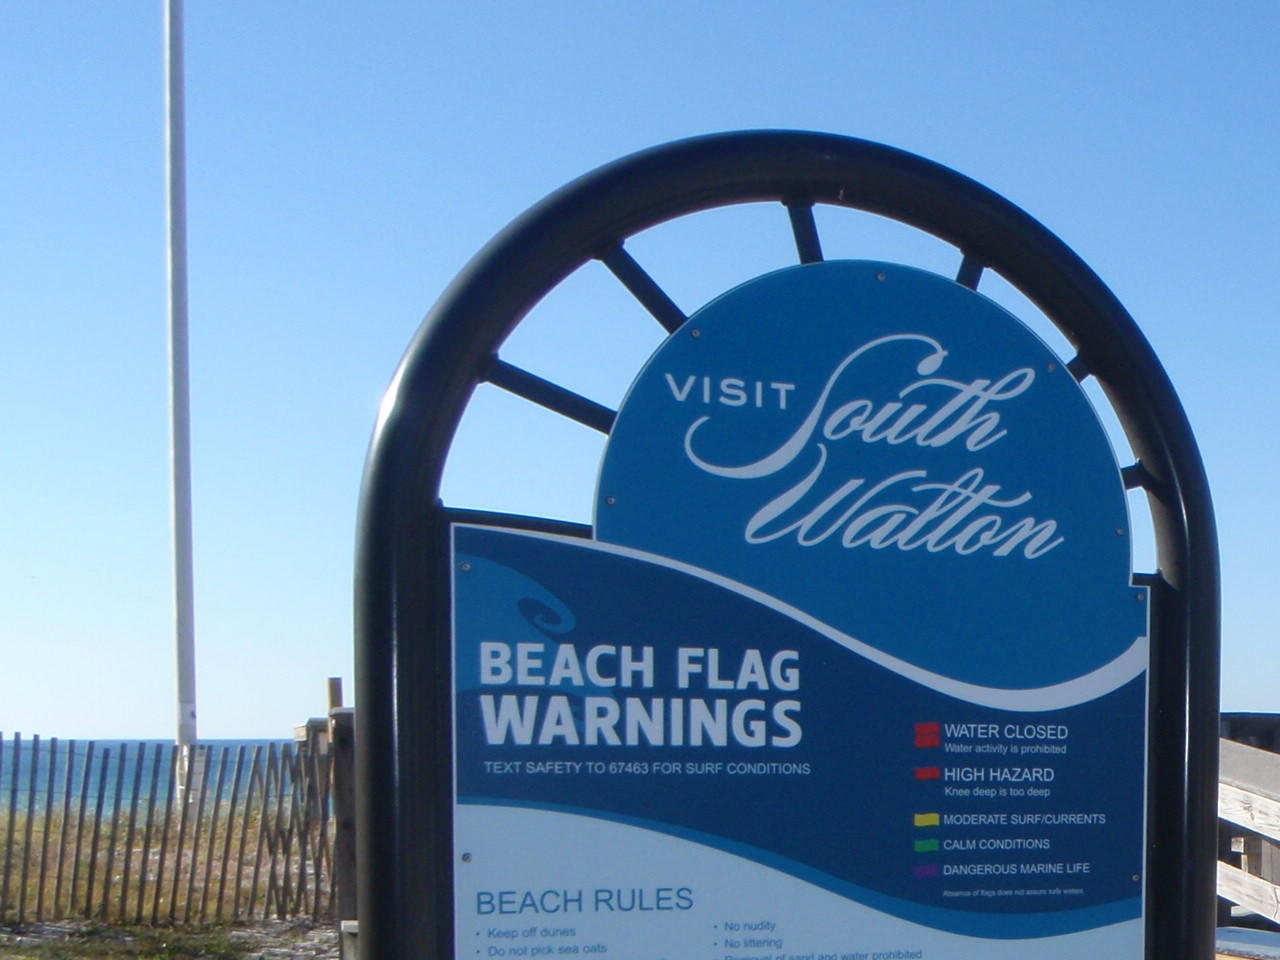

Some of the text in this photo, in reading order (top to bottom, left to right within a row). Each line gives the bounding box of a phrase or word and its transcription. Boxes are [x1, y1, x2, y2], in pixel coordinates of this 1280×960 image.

[665, 333, 1035, 480] VISIT South
[745, 443, 1065, 560] Walton
[481, 643, 799, 691] BEACH FLAG
[480, 695, 802, 747] WARNINGS
[945, 724, 1068, 739] WATER CLOSED
[945, 743, 1066, 755] Water activity is prohibited
[484, 762, 811, 775] TEXT SAFETY TO 67463 FOR SURF CONDITIONS
[945, 768, 1054, 782] HIGH HAZARD
[945, 787, 1050, 798] Knee deep is too deep
[944, 814, 1106, 824] MODERATE SURF/CURRENTS
[944, 839, 1050, 850] CALM CONDITIONS
[944, 863, 1089, 875] DANGEROUS MARINE LIFE
[477, 888, 693, 915] BEACH RULES
[725, 922, 776, 932] No nudity
[488, 928, 576, 940] Keep off dunes
[724, 939, 782, 949] No littering
[488, 944, 607, 957] Do not pick sea oats
[841, 953, 868, 960] water
